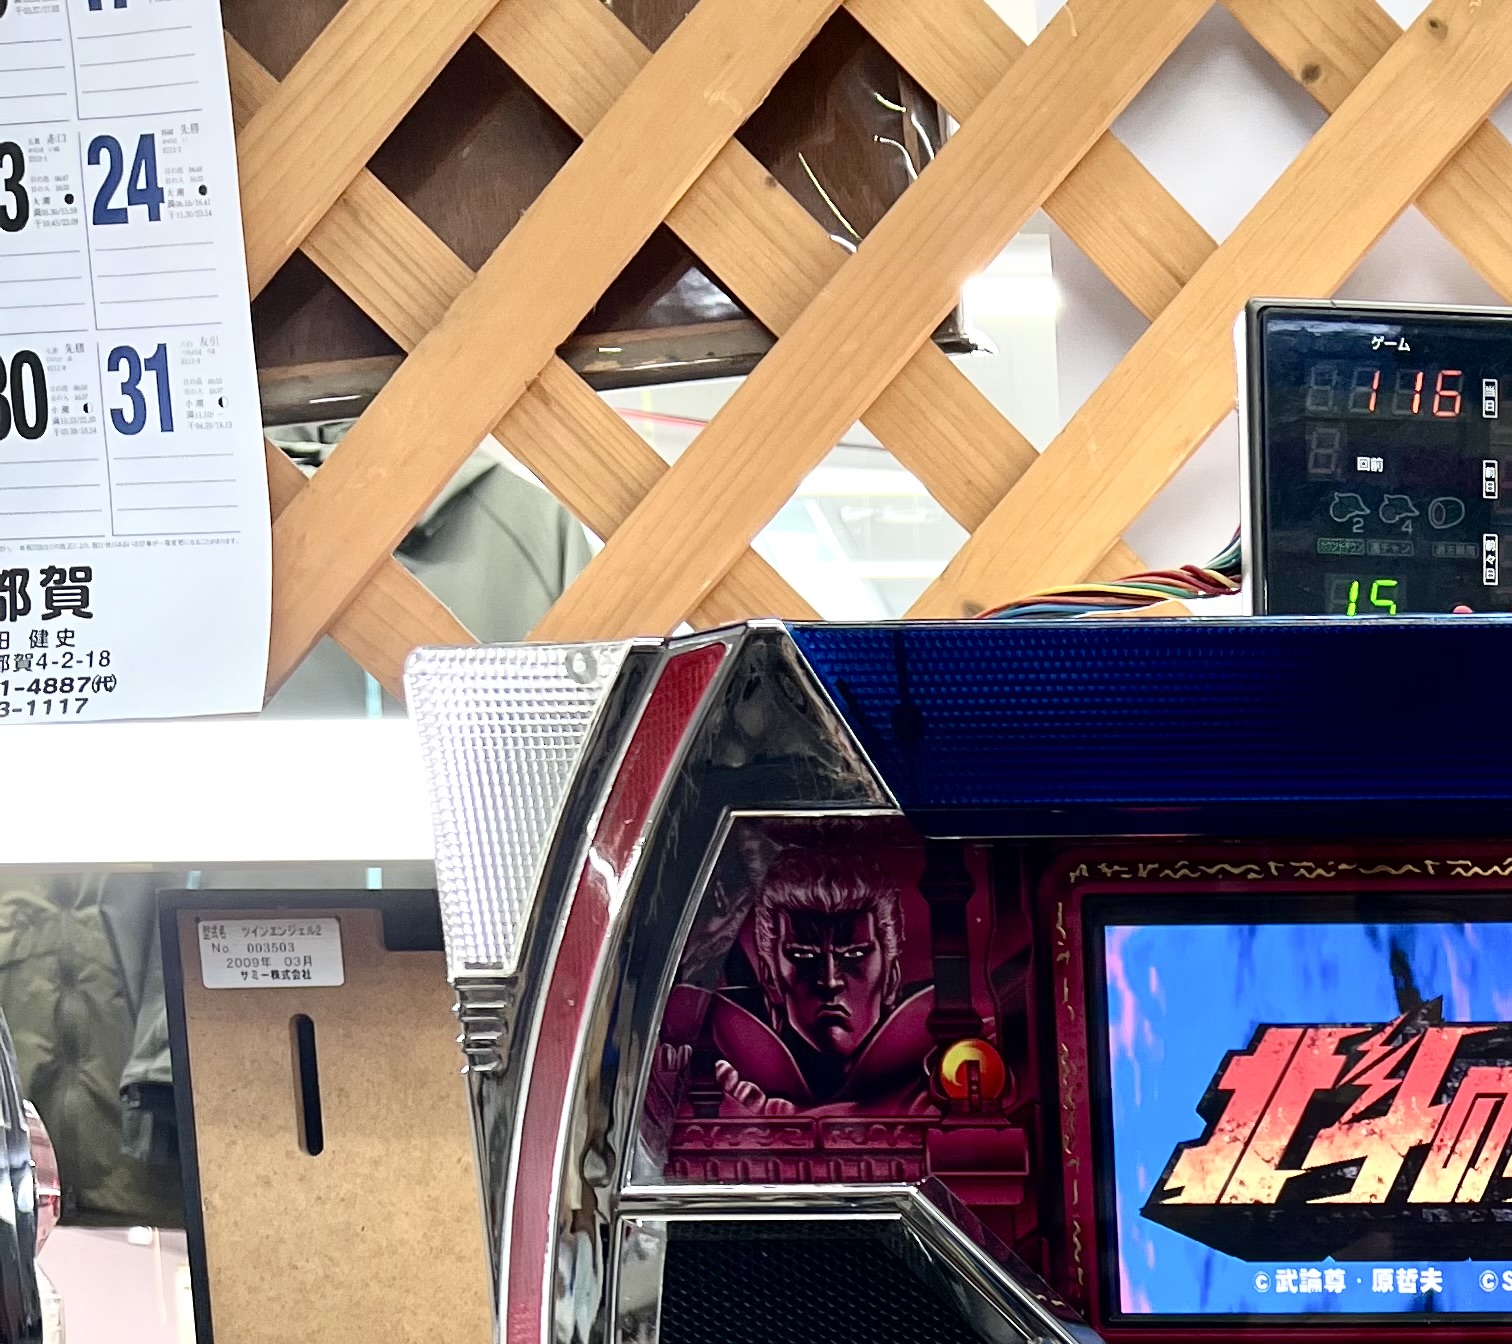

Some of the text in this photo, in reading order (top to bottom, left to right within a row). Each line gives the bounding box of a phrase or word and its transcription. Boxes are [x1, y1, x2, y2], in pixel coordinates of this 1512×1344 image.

[88, 133, 165, 225] 24
[1371, 337, 1411, 352] ゲーム
[107, 343, 175, 436] 31
[1368, 369, 1464, 418] 116
[1357, 456, 1384, 473] 回前
[1352, 517, 1365, 533] 2
[1401, 519, 1414, 535] 4
[247, 942, 295, 954] 003503
[226, 955, 313, 969] 2009年 03月
[241, 969, 312, 981] サミー株式会社
